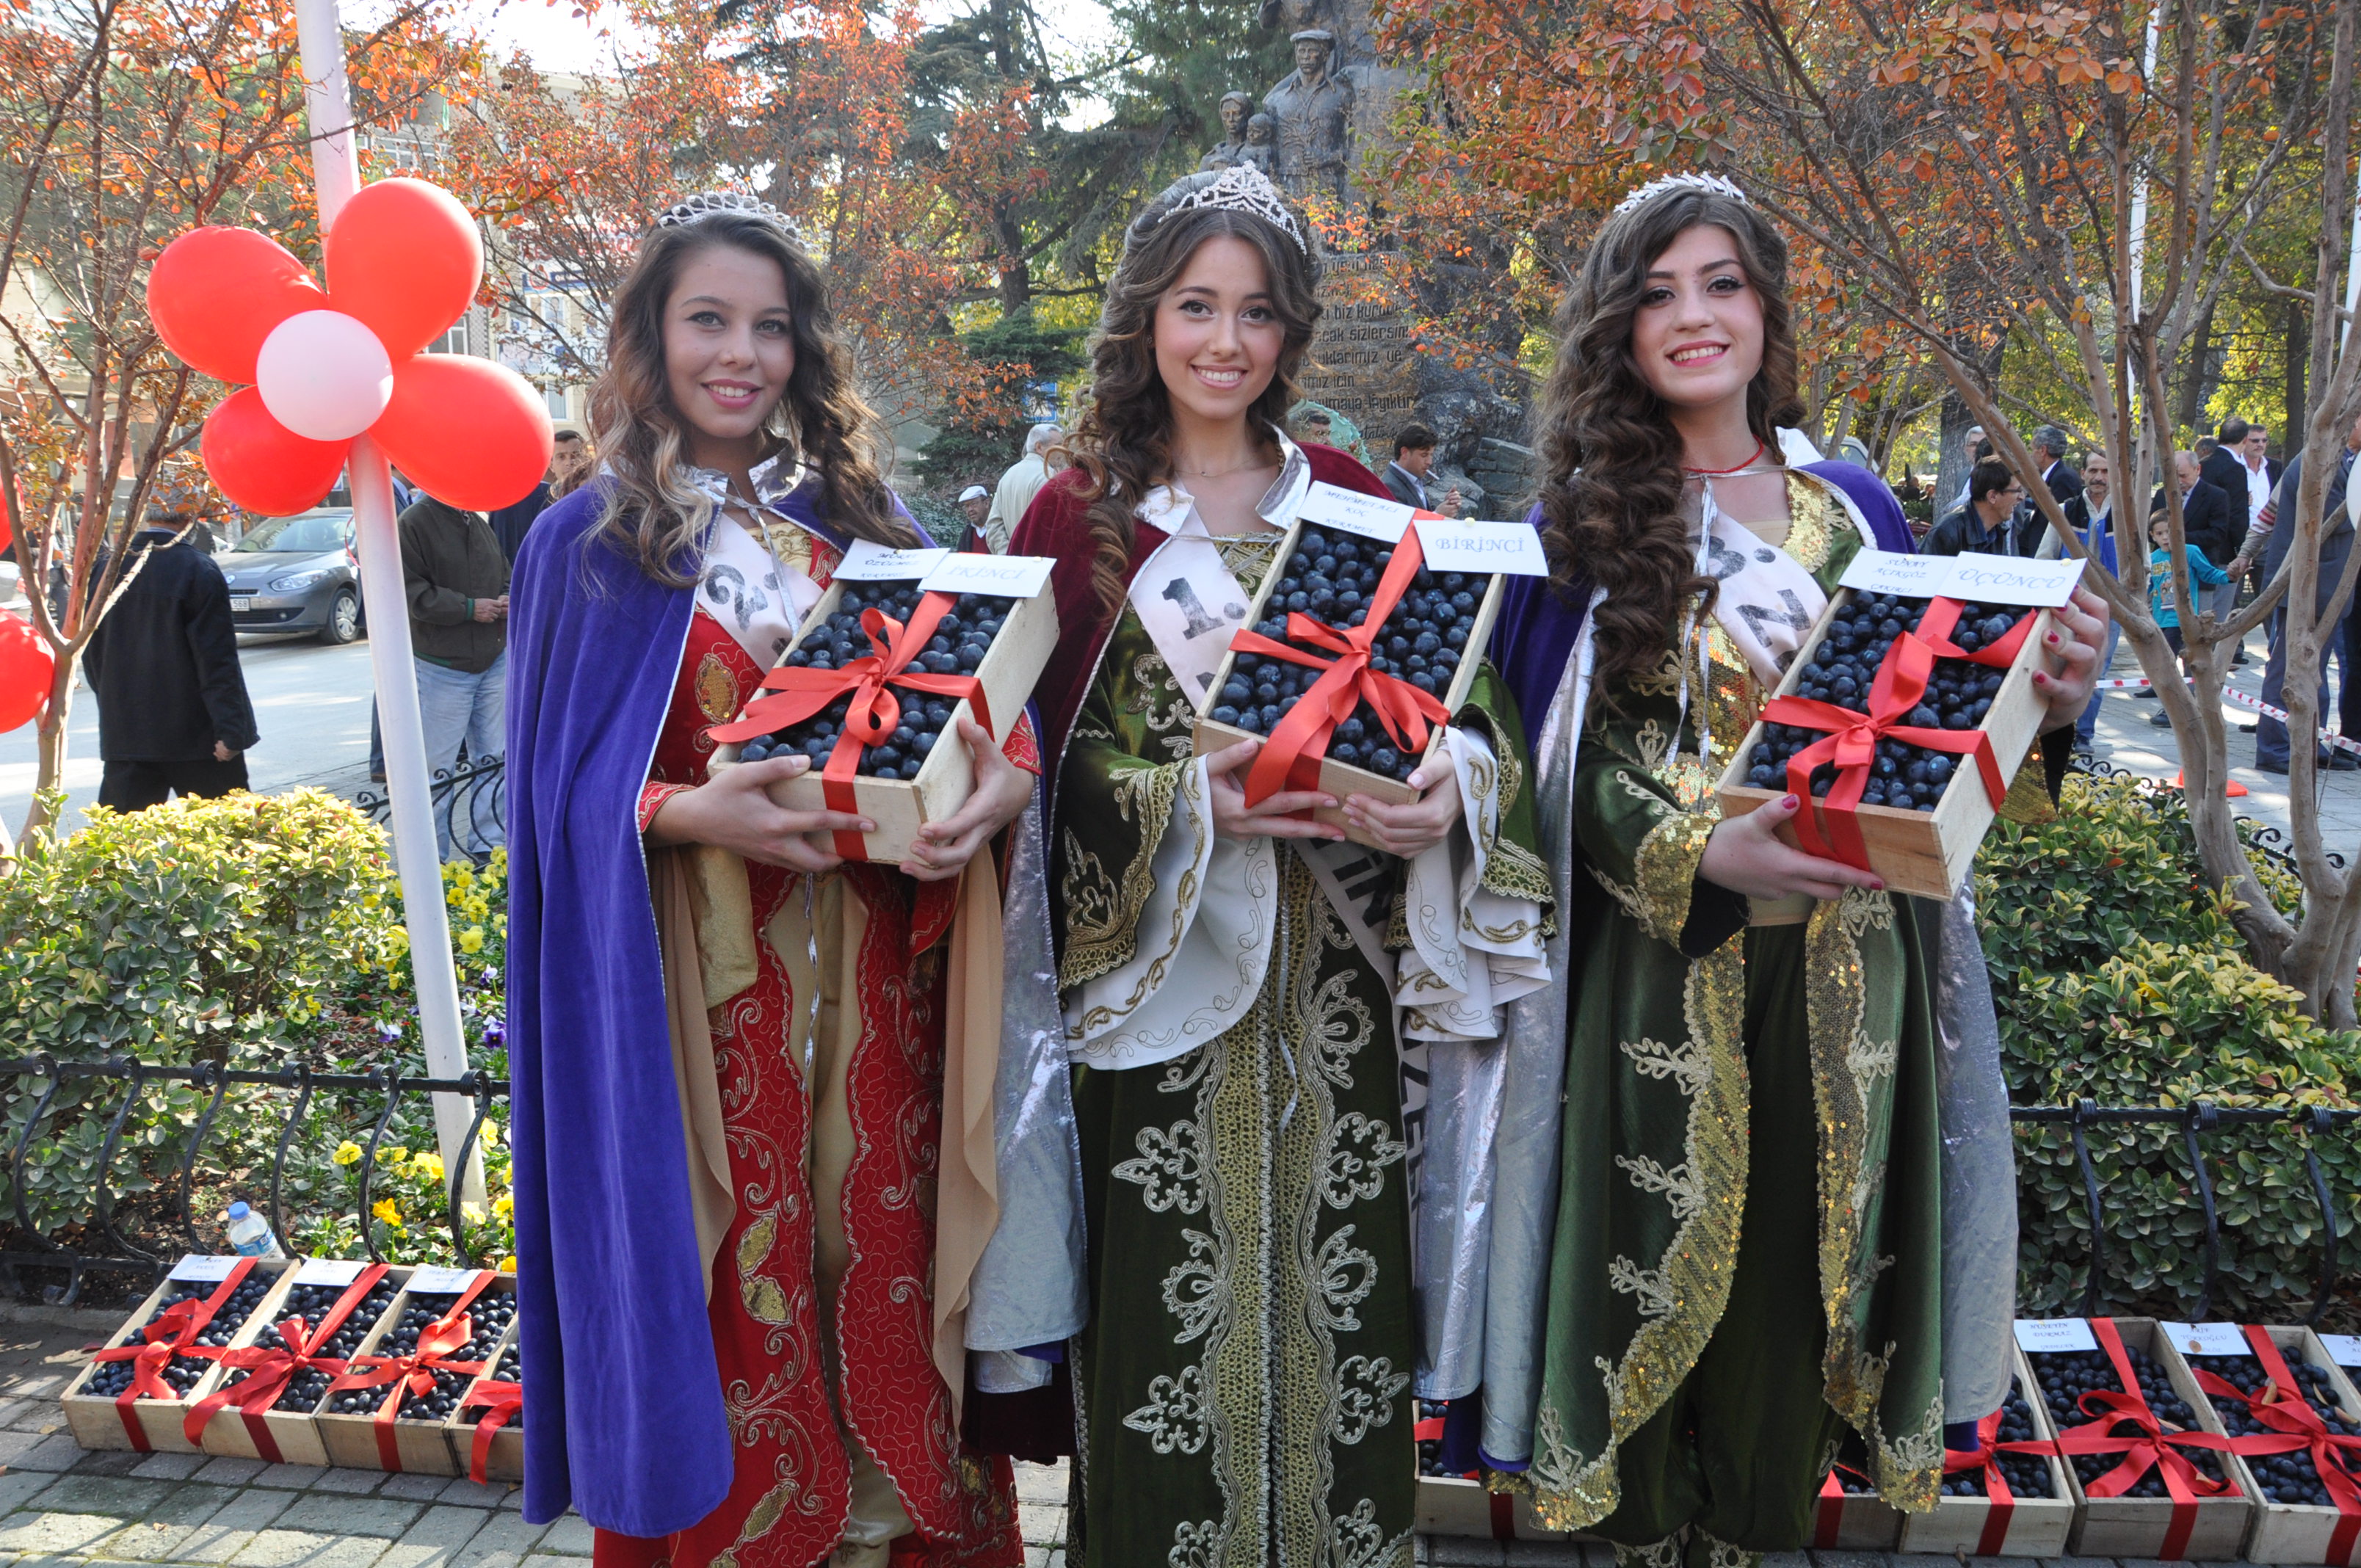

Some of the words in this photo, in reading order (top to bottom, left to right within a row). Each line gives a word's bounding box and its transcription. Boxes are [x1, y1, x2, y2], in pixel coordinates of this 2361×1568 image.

[1335, 303, 1353, 320] biz
[1435, 535, 1525, 553] BİRİNCİ
[1958, 567, 2066, 589] ÜÇÜNCÜ
[1161, 576, 1247, 641] 1.
